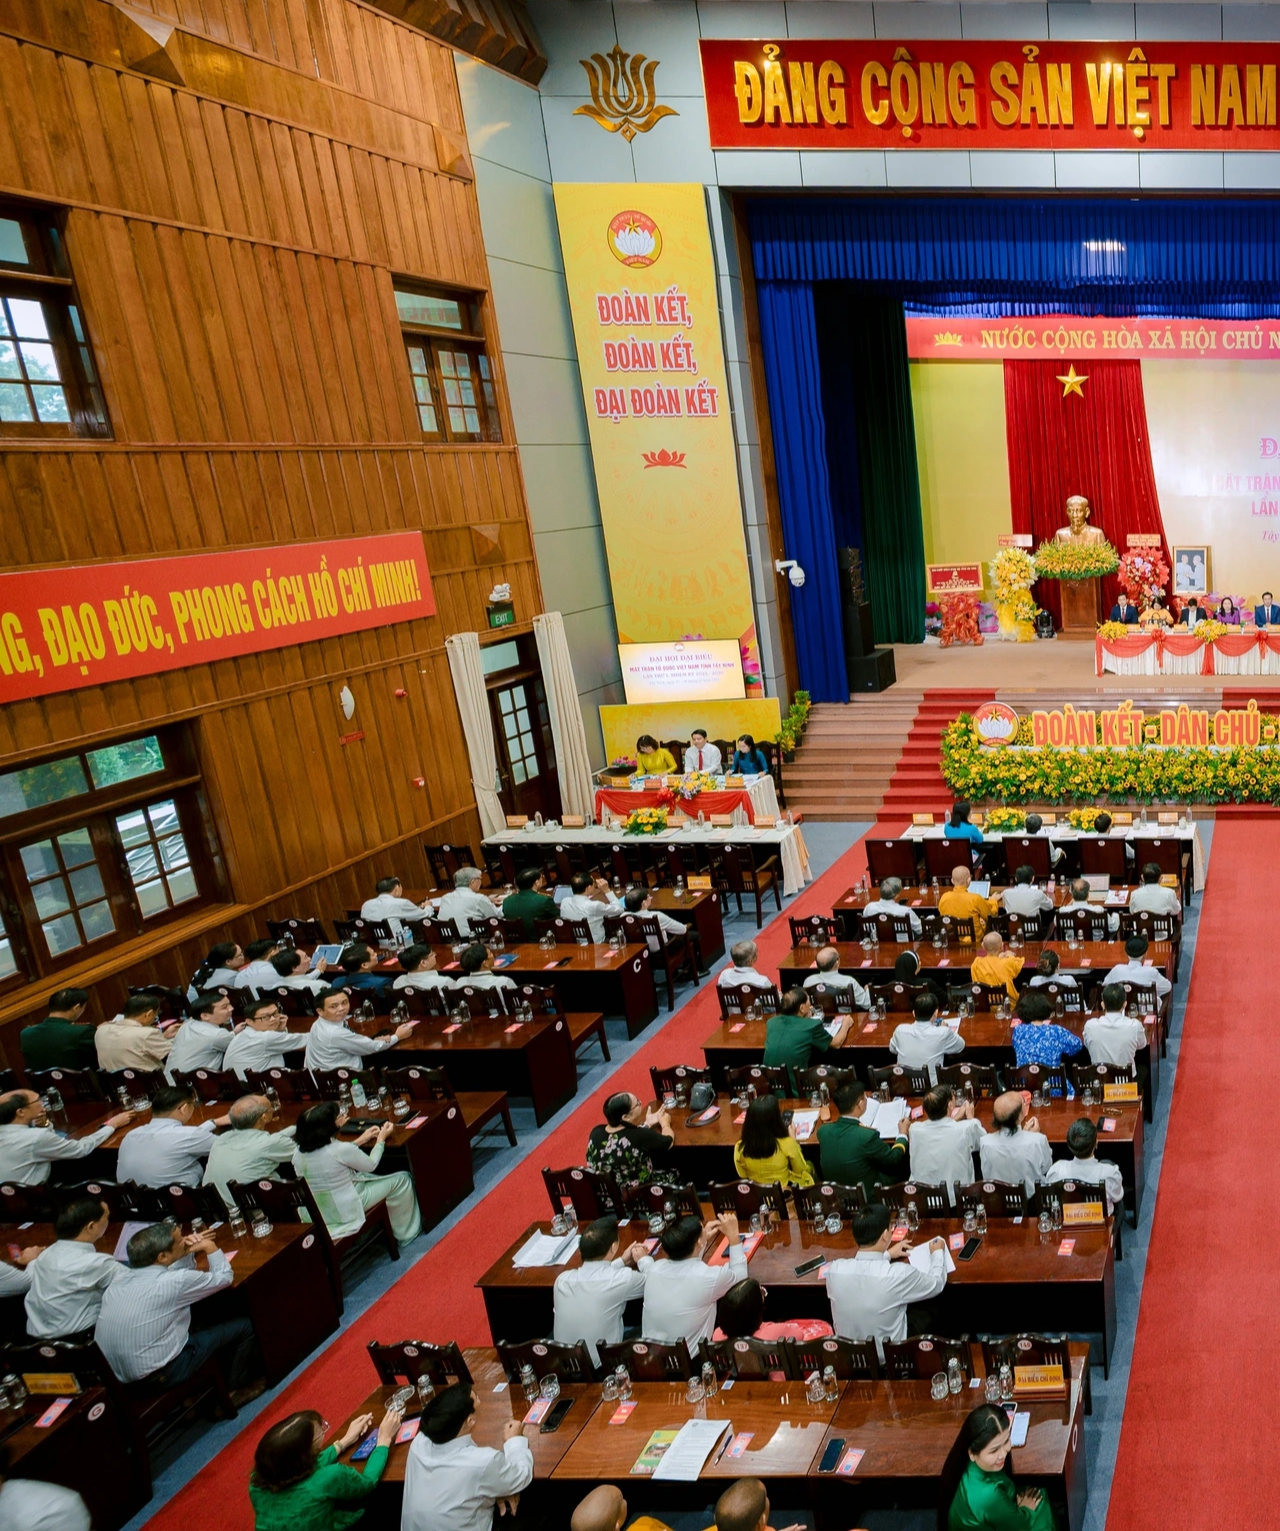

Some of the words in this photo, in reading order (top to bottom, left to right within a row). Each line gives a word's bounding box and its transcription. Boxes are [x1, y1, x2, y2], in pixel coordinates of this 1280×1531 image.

[734, 43, 845, 124] ĐẢNG
[860, 47, 976, 138] CỘNG
[990, 45, 1074, 125] SẢN
[1085, 47, 1176, 138] VIỆT
[1191, 64, 1277, 126] NAM
[598, 290, 650, 323] ĐOÀN
[654, 287, 692, 326] KẾT,
[605, 337, 656, 369] ĐOÀN
[660, 334, 697, 373] KẾT,
[981, 325, 1037, 349] NƯỚC
[1042, 326, 1096, 354] CỘNG
[1103, 325, 1143, 349] HÒA
[1148, 325, 1175, 350] XÃ
[1180, 326, 1217, 354] HỘI
[1222, 325, 1263, 350] CHỦ
[595, 388, 627, 421] ĐẠI
[630, 384, 681, 414] ĐOÀN
[685, 380, 717, 414] KẾT
[1251, 496, 1279, 516] LẦN
[1262, 531, 1279, 544] Tây
[38, 602, 105, 676] ĐẠO
[103, 585, 175, 653] ĐỨC,
[169, 582, 254, 644] PHONG
[253, 568, 307, 629] CÁCH
[307, 554, 339, 619] HỒ
[337, 556, 371, 613] CHÍ
[370, 559, 422, 609] MINH!
[1033, 706, 1096, 746] ĐOÀN
[1102, 701, 1144, 746] KẾT
[1161, 706, 1208, 746] DÂN
[1215, 700, 1260, 746] CHỦ
[634, 959, 641, 973] C
